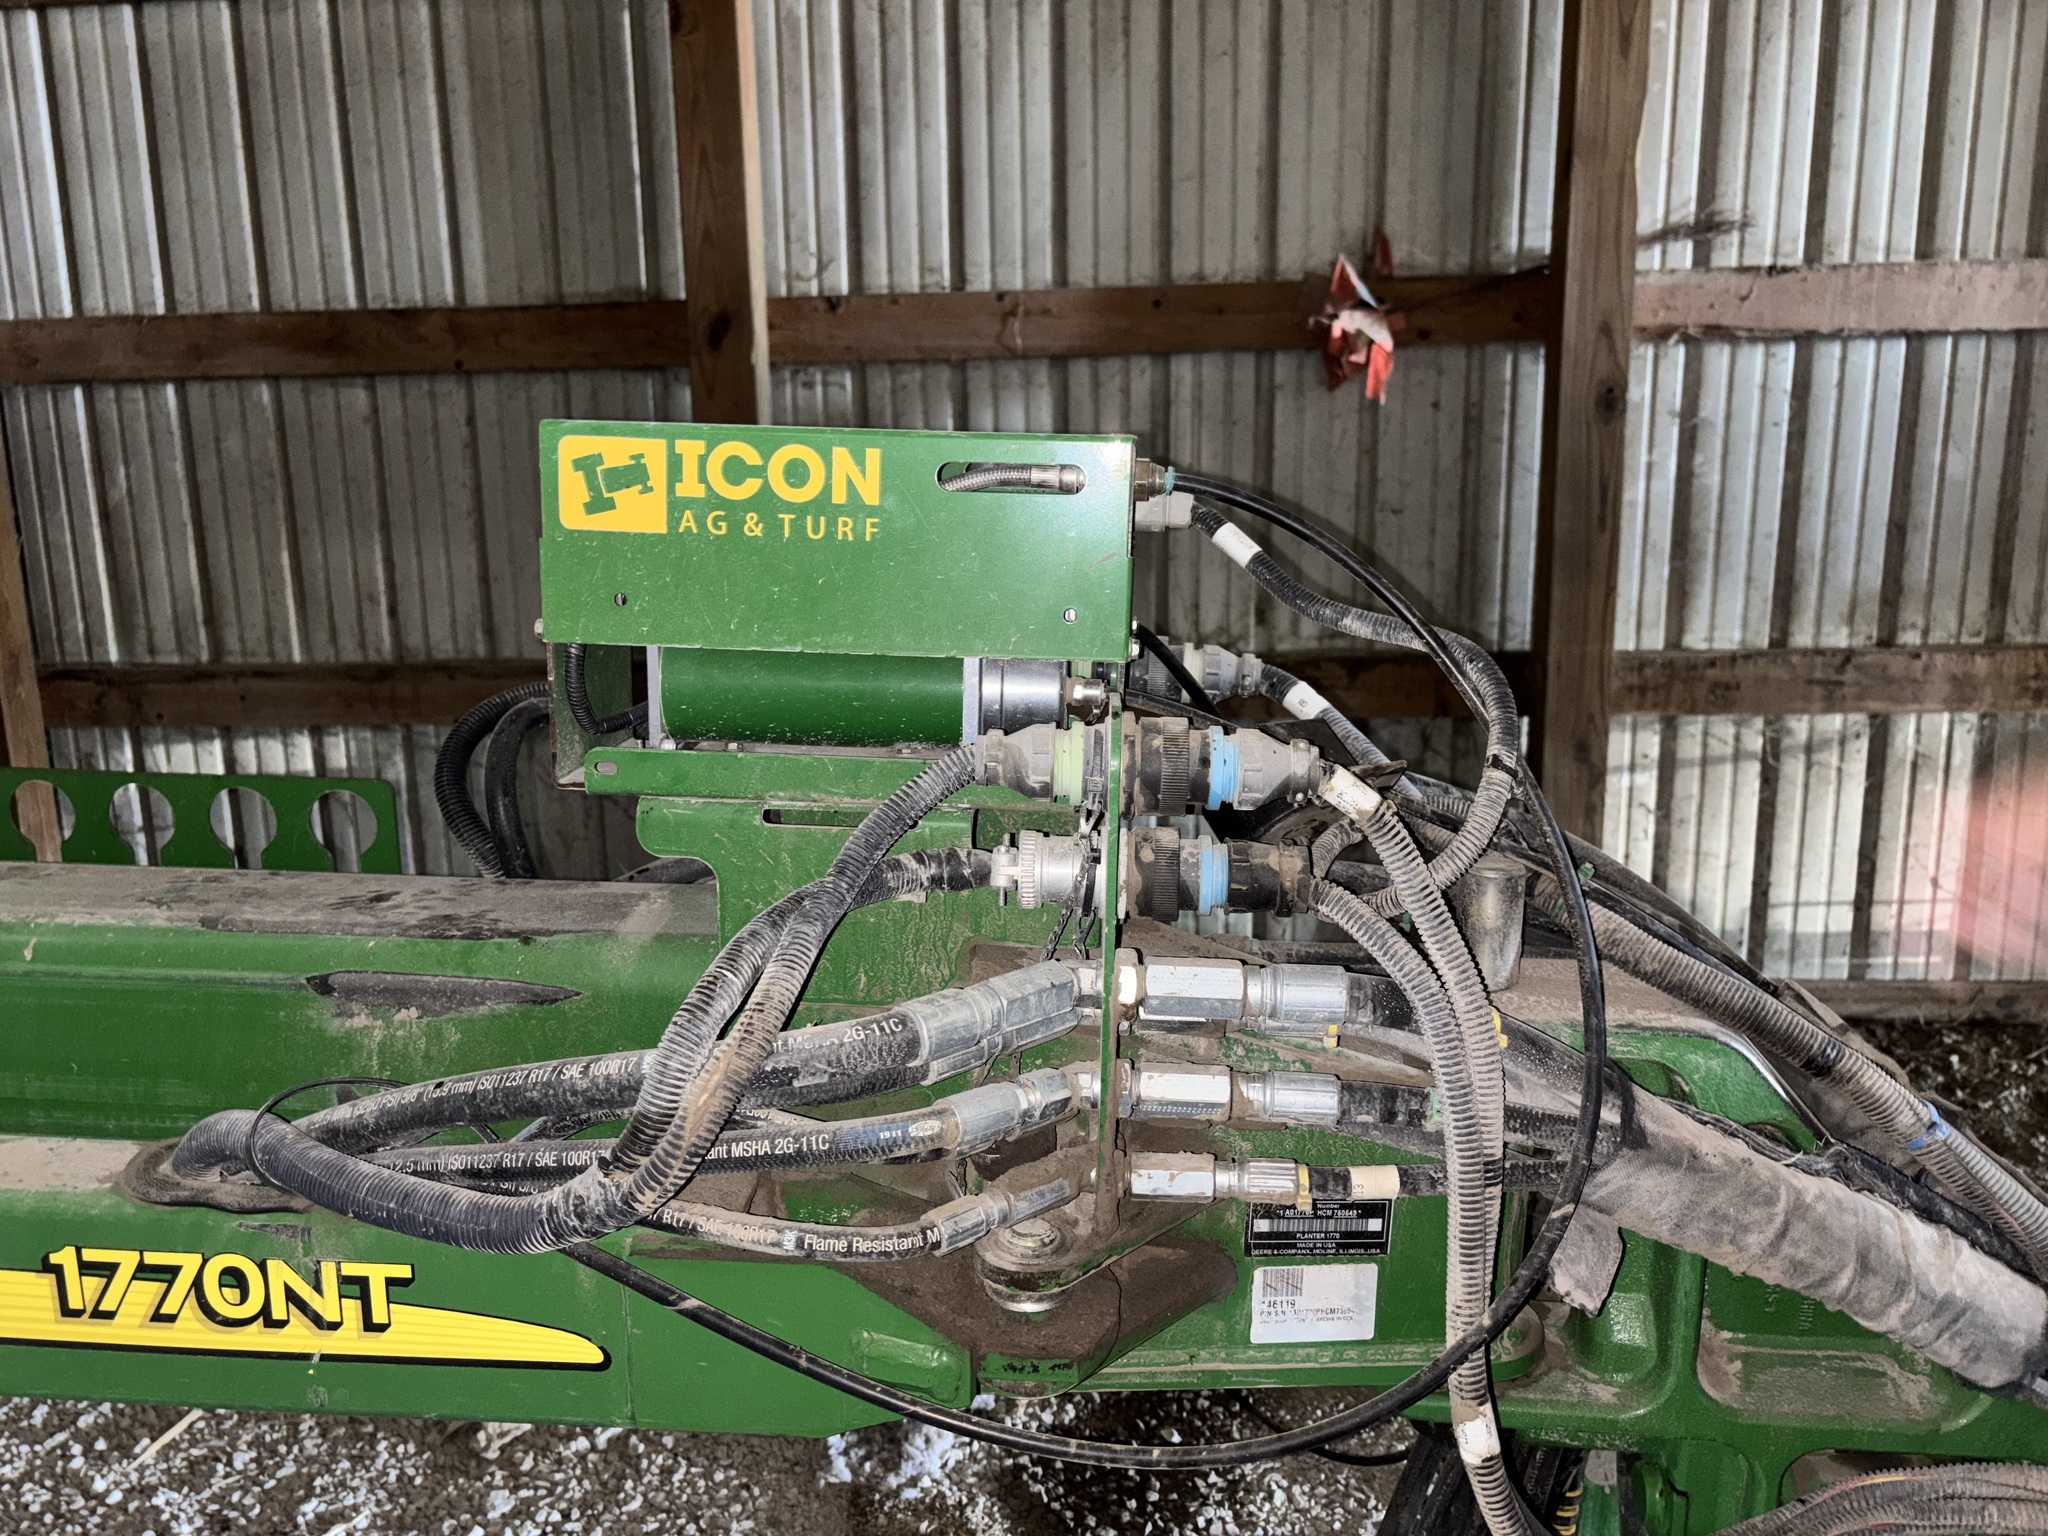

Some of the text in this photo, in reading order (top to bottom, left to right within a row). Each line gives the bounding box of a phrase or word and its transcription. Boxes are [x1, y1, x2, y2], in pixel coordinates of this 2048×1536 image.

[674, 439, 882, 506] ICON
[678, 511, 880, 541] AG & TURF
[843, 1017, 903, 1043] 2G-11C
[528, 1067, 552, 1084] R17
[560, 1063, 587, 1080] SAE
[588, 1058, 638, 1077] 100R17
[731, 1139, 771, 1159] MSHA
[774, 1134, 829, 1153] 2G-11C
[879, 1129, 902, 1139] 1911
[502, 1152, 525, 1168] R17
[535, 1150, 557, 1167] SAE
[1317, 1209, 1333, 1217] HCM
[664, 1209, 690, 1229] R17
[782, 1229, 798, 1250] M3K
[804, 1233, 848, 1252] Flame
[852, 1232, 924, 1253] Resistant
[44, 1246, 414, 1334] 1770NT
